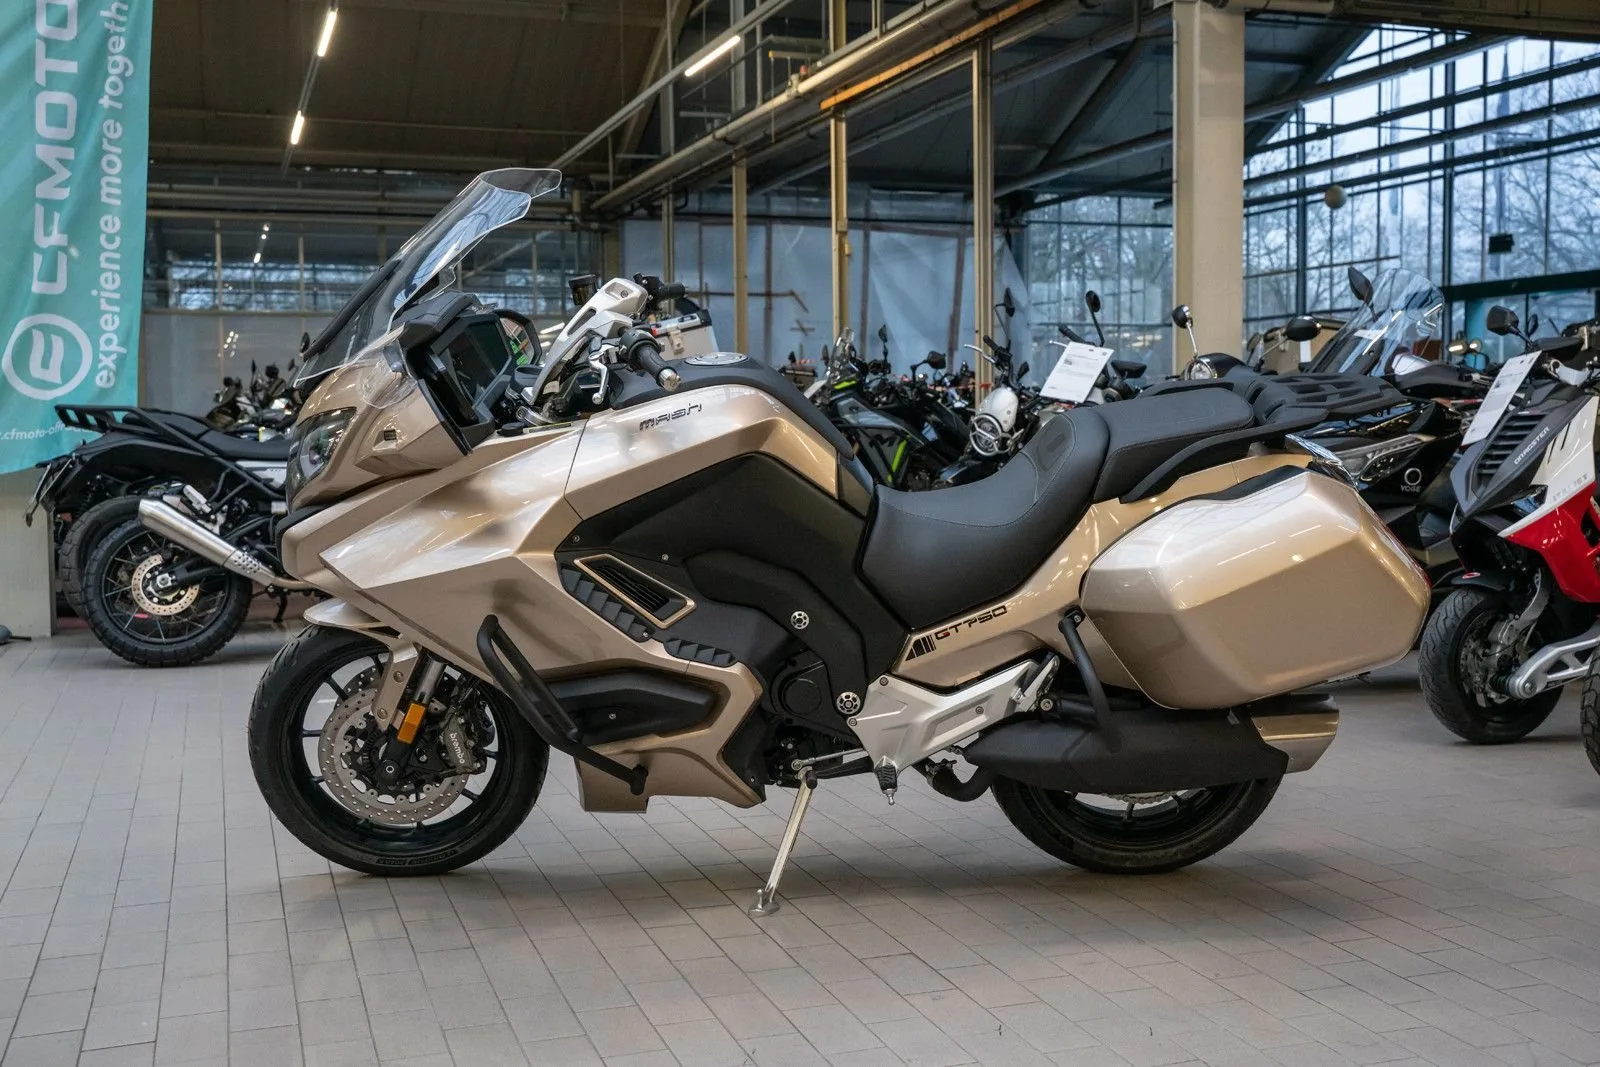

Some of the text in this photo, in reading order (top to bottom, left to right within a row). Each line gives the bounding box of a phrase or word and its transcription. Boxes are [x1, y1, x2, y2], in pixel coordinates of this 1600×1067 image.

[32, 0, 78, 294] CFMOTO
[91, 2, 134, 388] experience more togeth
[934, 604, 1008, 641] GT750
[450, 732, 465, 764] brembo
